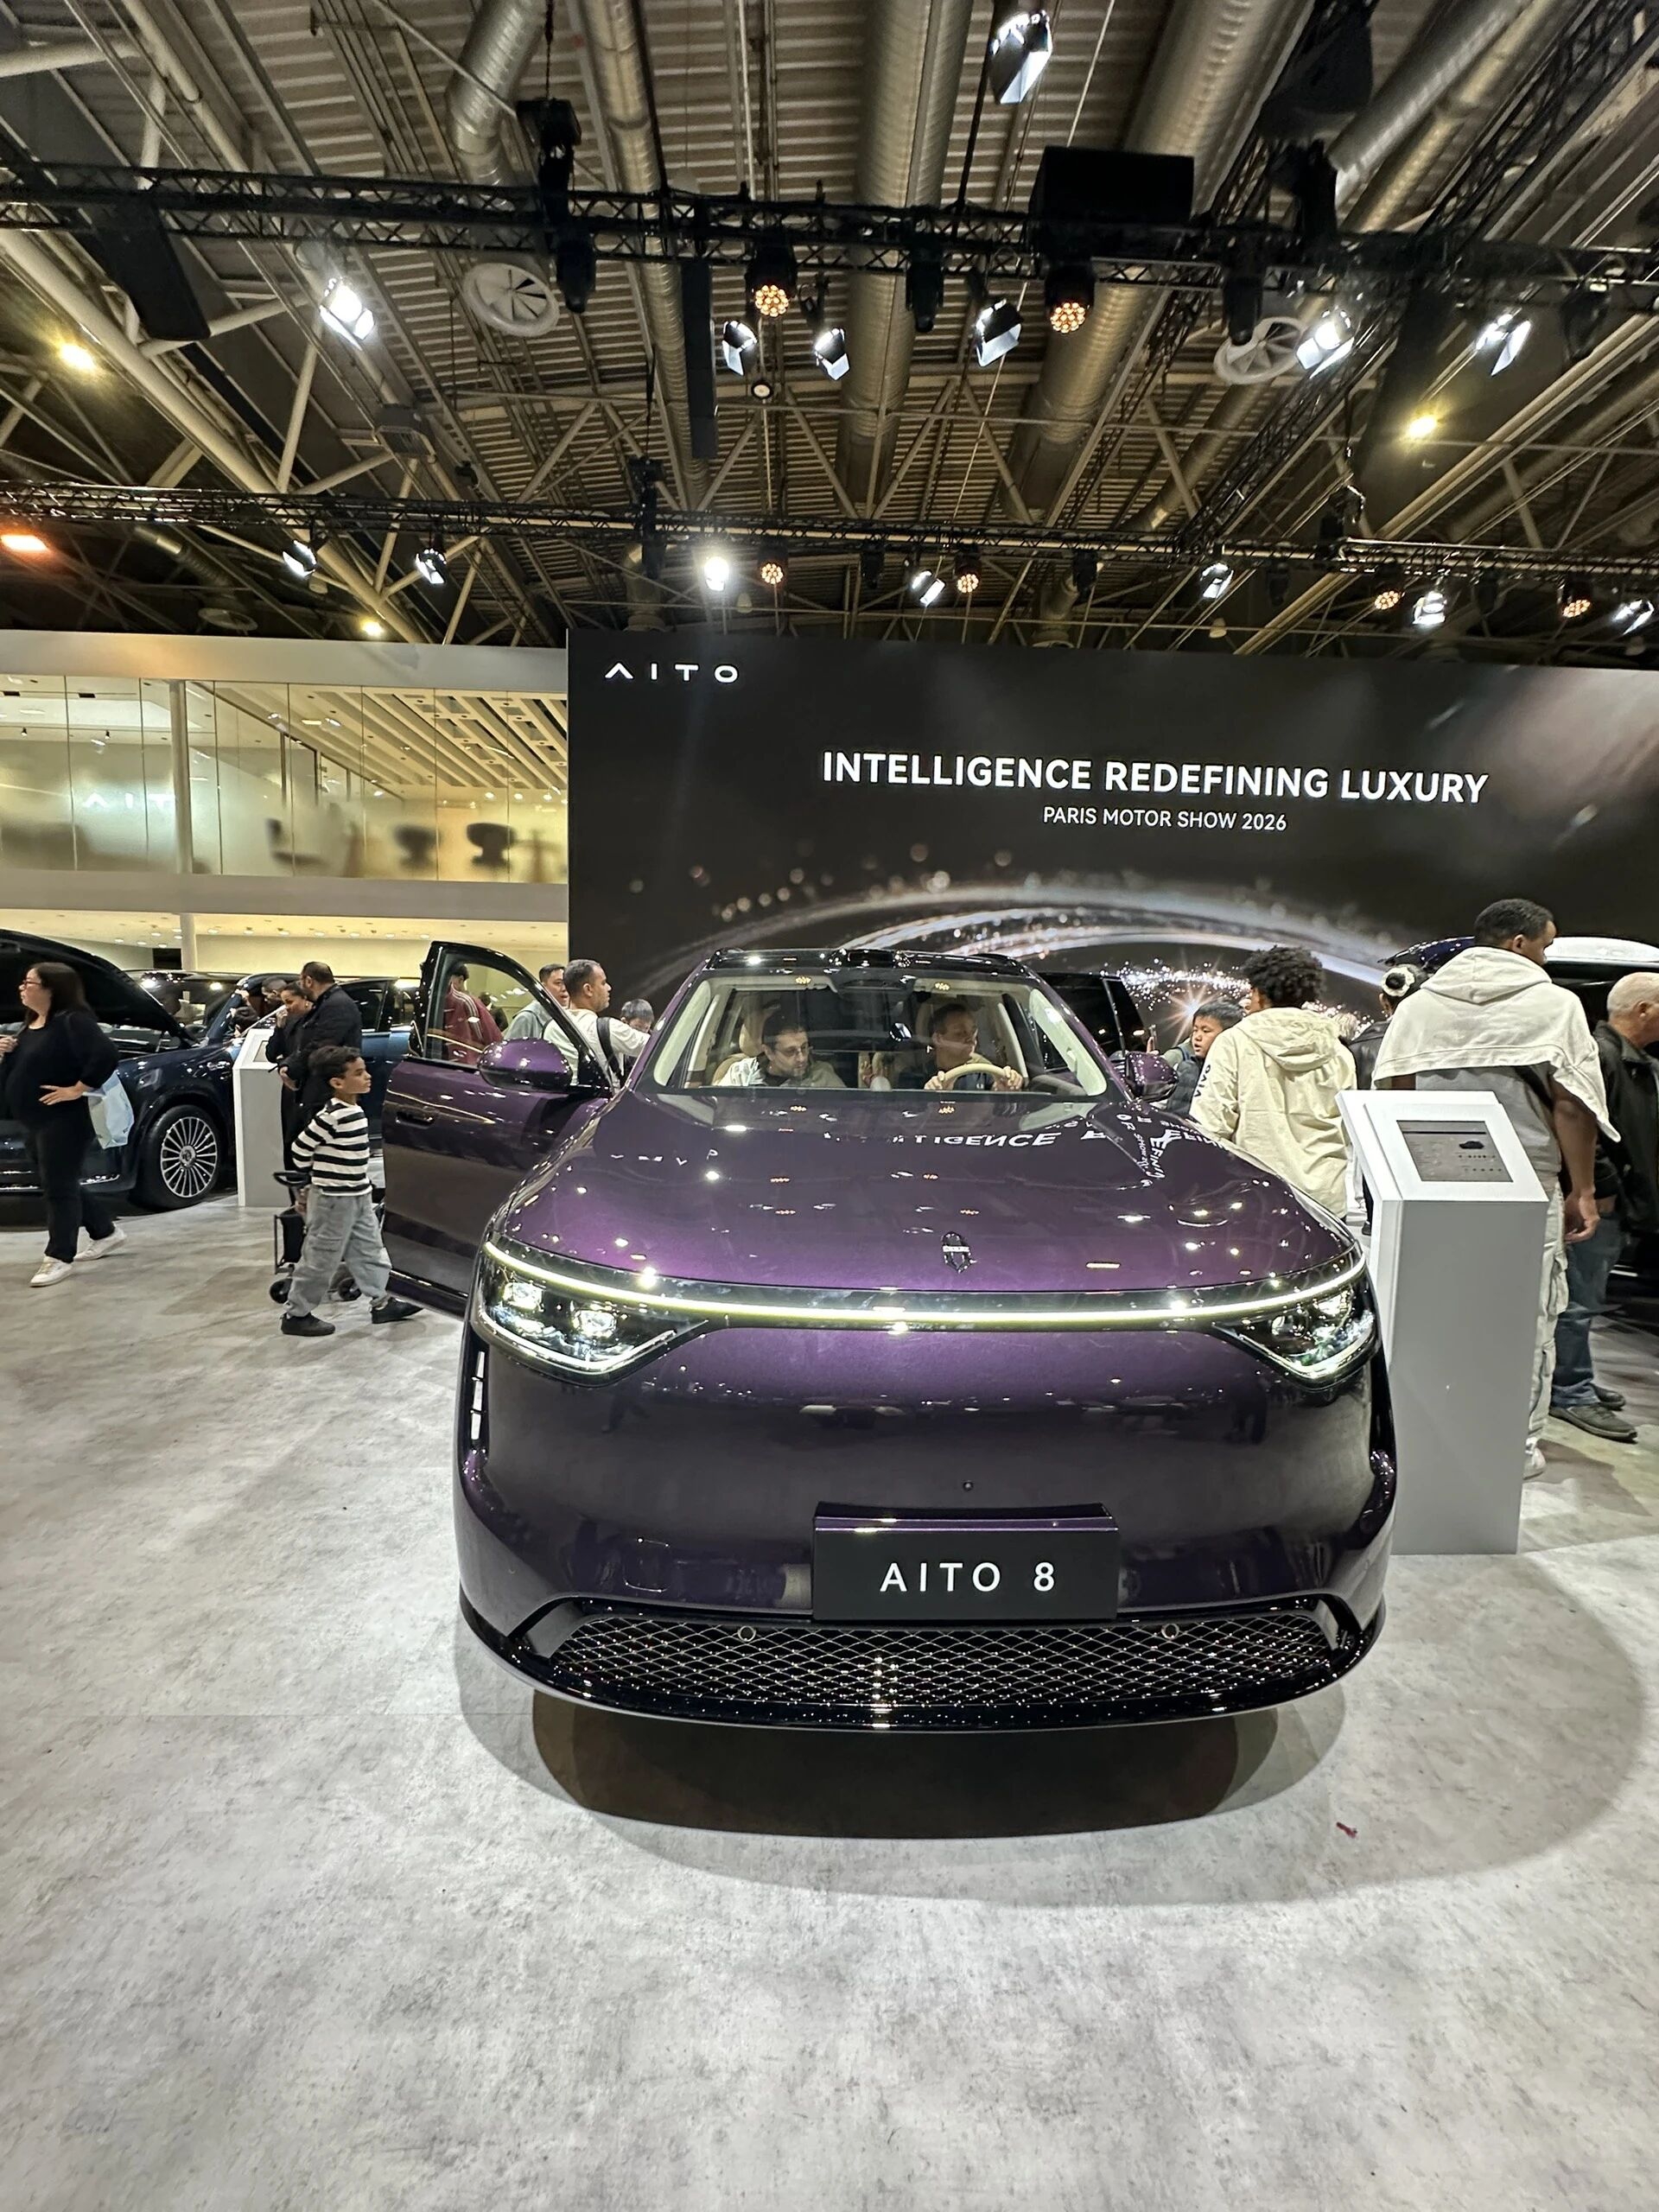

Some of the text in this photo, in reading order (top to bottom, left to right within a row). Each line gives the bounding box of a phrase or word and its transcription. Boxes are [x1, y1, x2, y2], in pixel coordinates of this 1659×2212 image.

[604, 662, 738, 683] AITO
[822, 752, 1489, 804] INTELLIGENCE REDEFINING LUXURY
[1043, 806, 1287, 831] PARIS MOTOR SHOW 2026
[880, 1561, 1055, 1592] AITO 8
